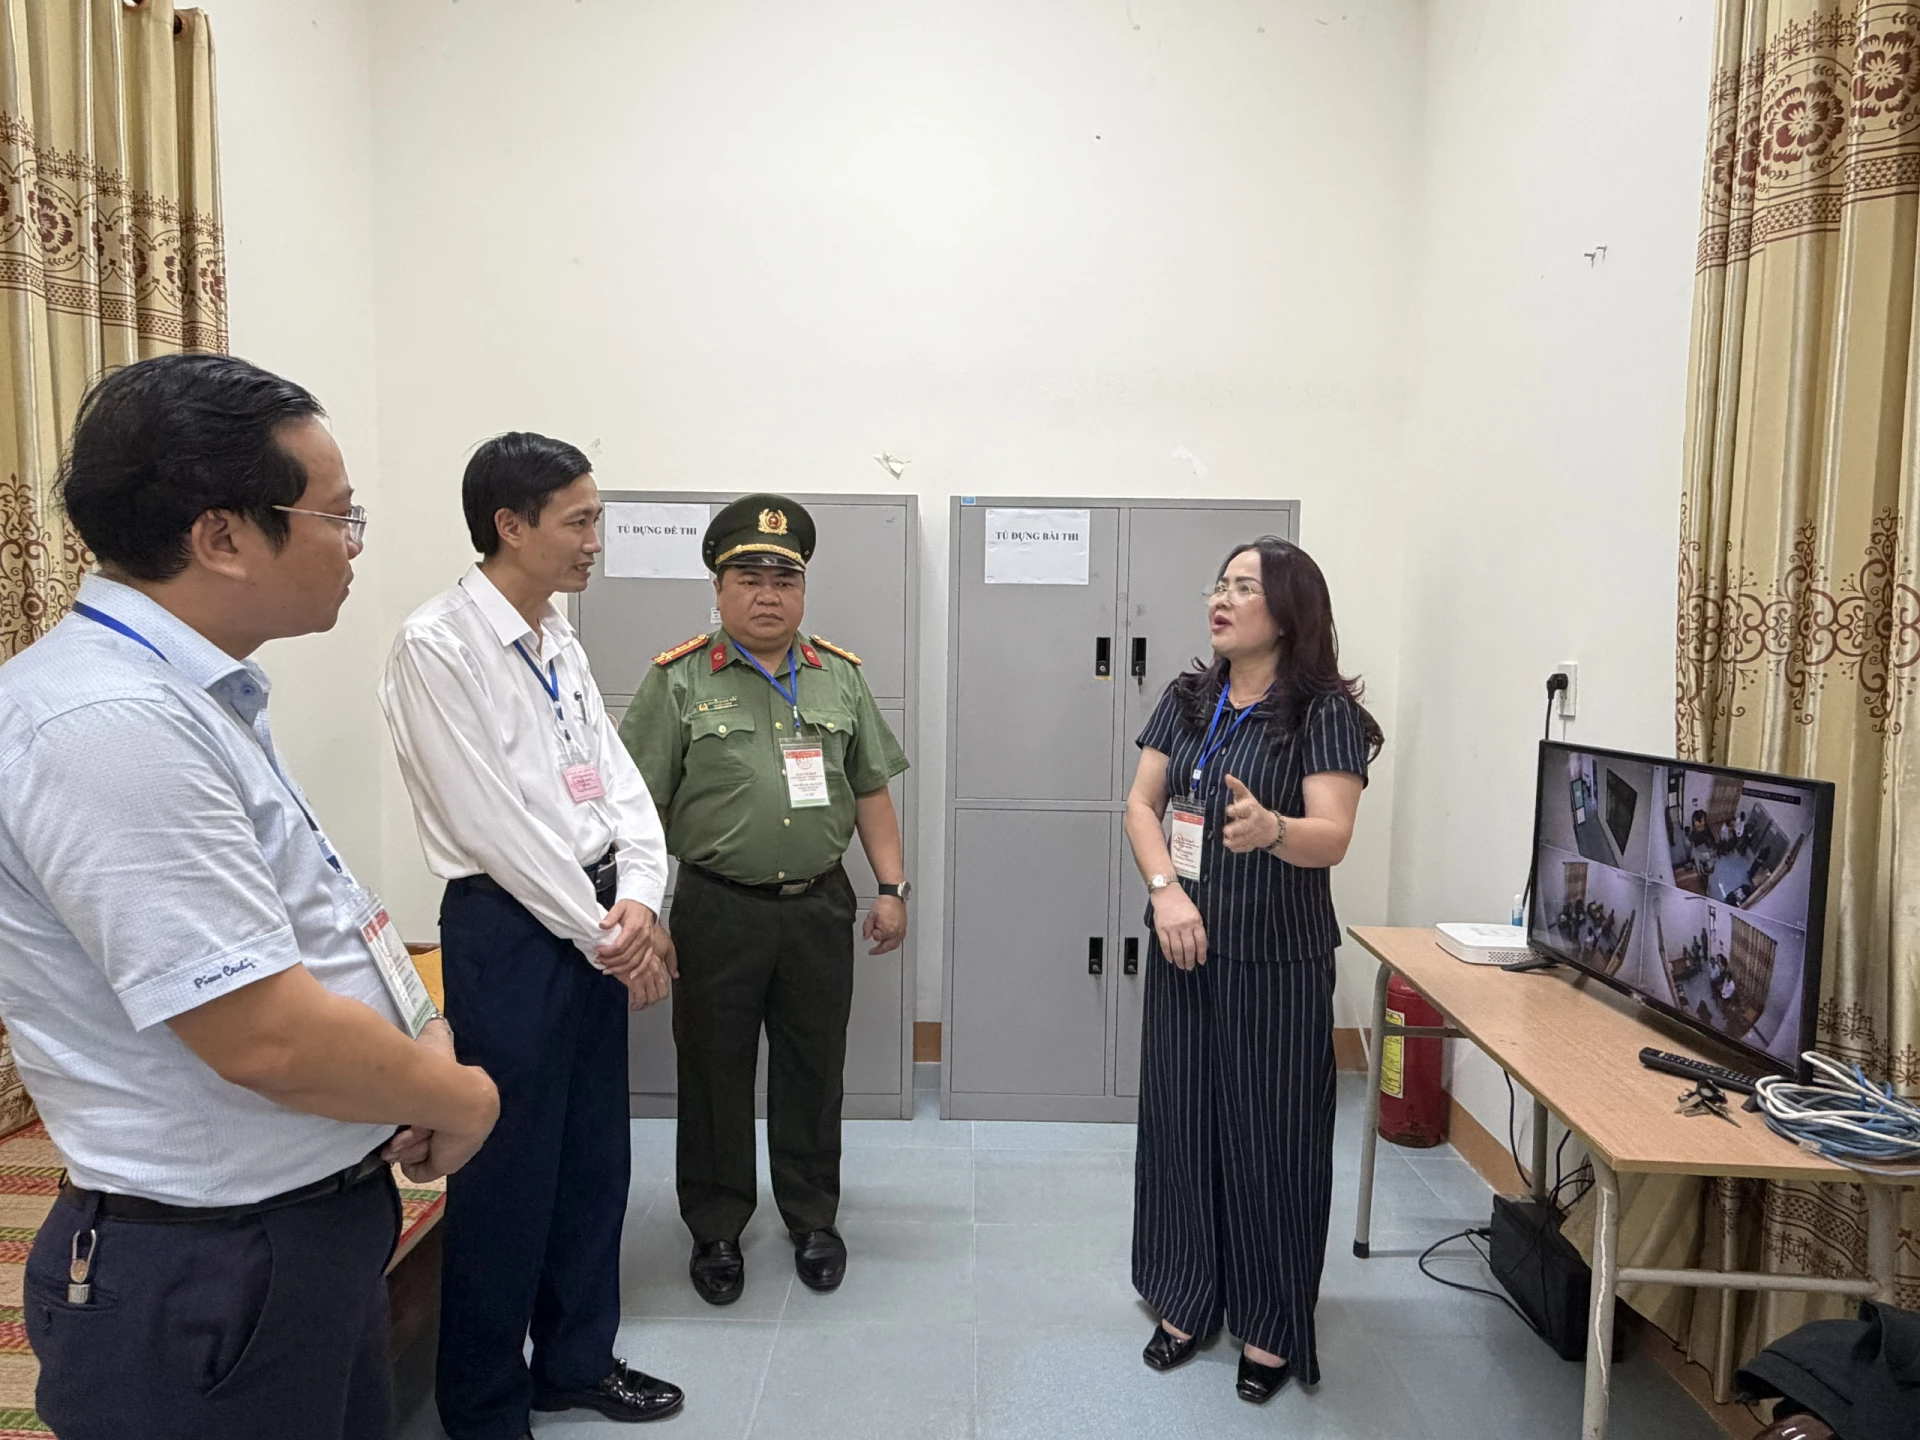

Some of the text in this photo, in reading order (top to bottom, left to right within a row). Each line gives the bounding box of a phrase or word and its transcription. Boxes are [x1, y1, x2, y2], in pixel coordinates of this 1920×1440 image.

[617, 524, 630, 534] TỦ
[633, 525, 662, 536] ĐỰNG
[680, 527, 697, 535] THI
[996, 530, 1079, 542] TỦ ĐỰNG BÀI THI
